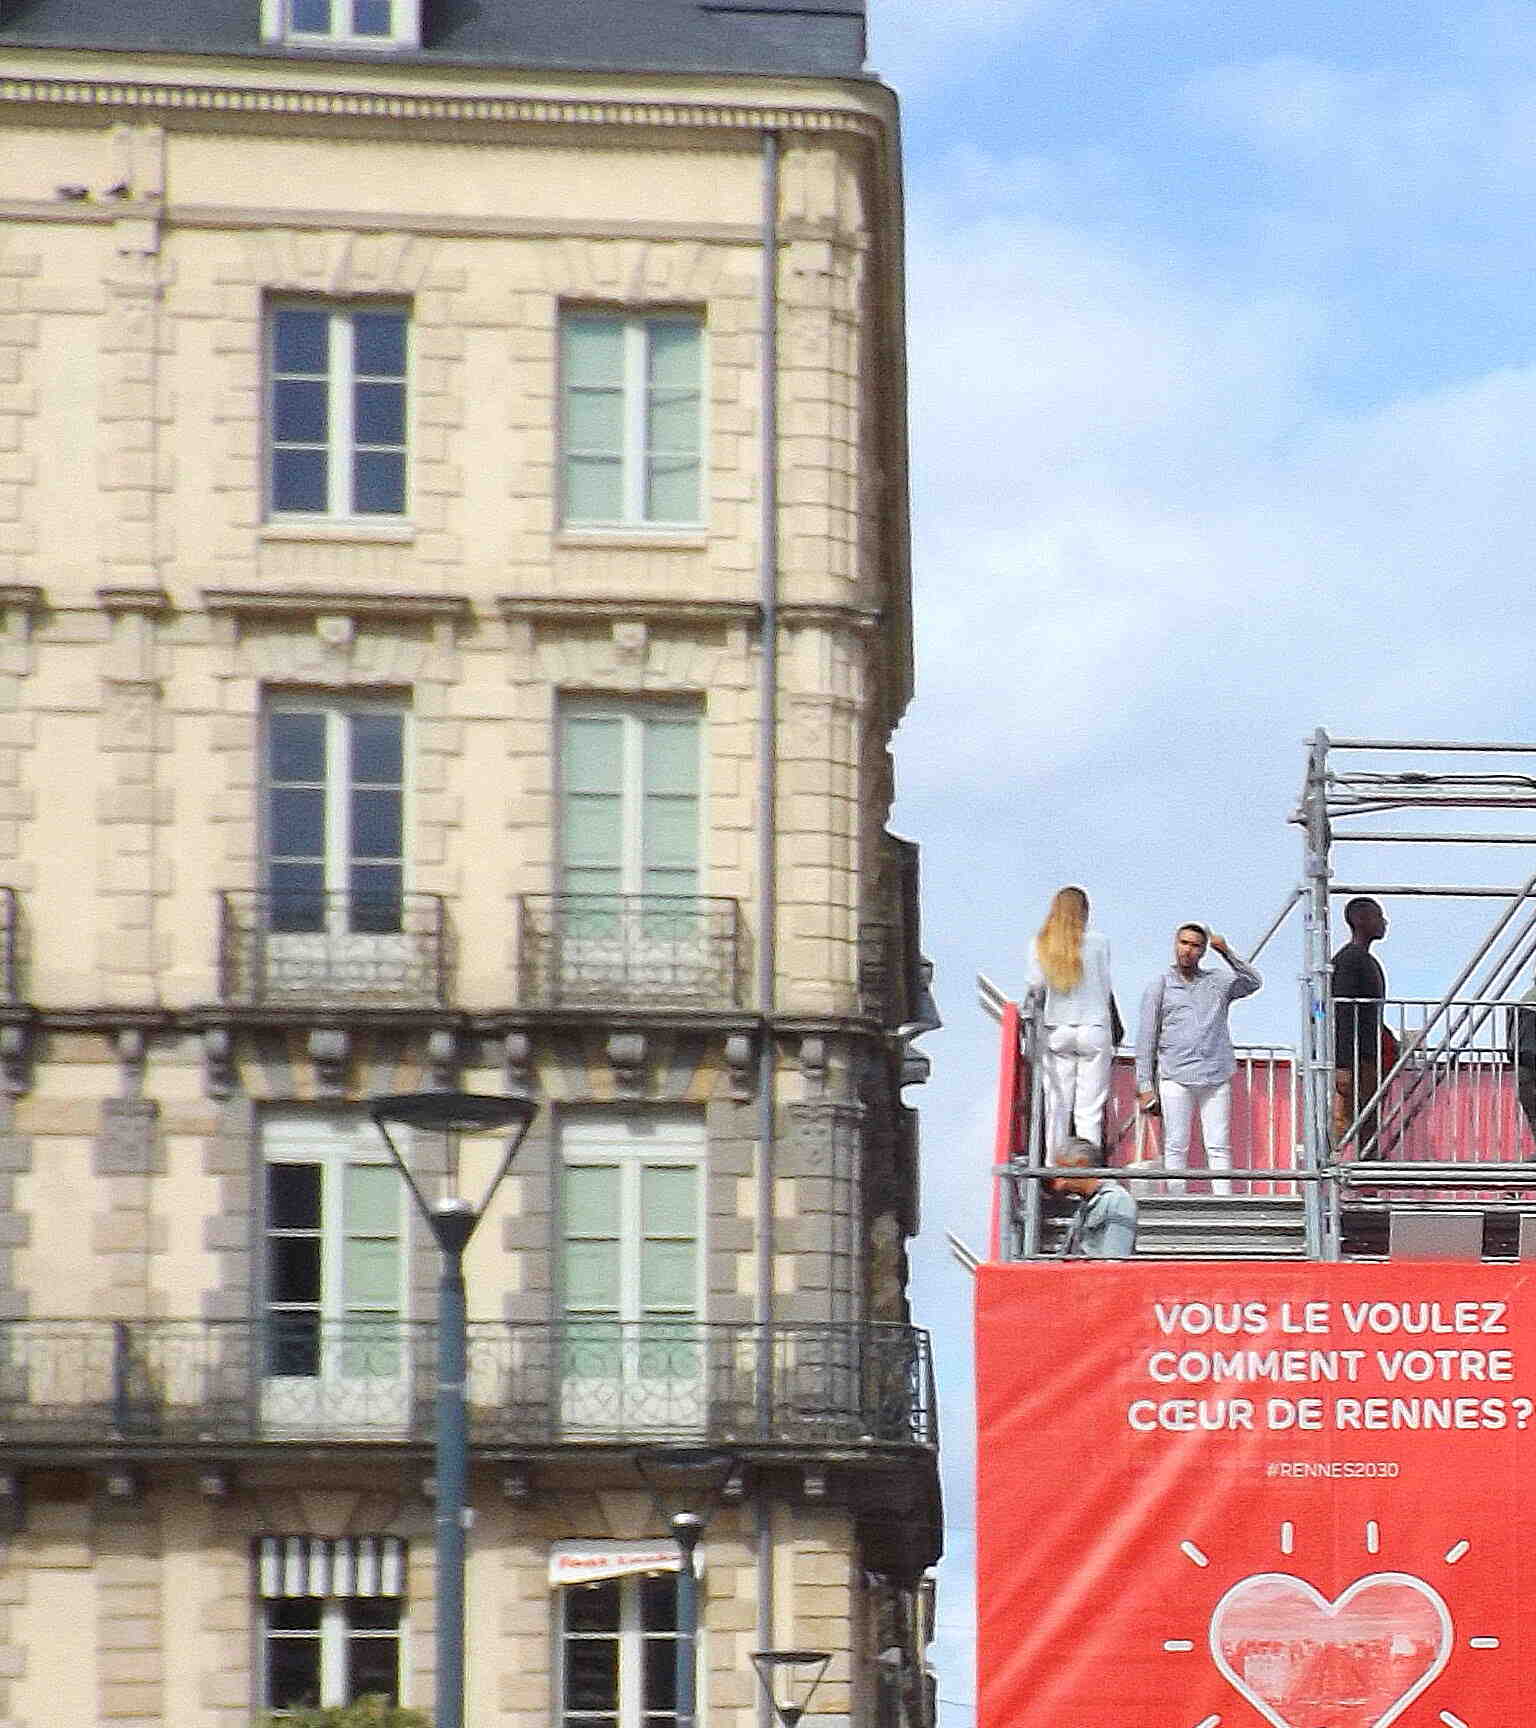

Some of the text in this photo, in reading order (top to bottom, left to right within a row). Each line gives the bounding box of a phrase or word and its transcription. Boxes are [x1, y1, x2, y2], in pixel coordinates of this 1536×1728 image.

[1155, 1302, 1509, 1335] VOUS LE VOULEZ
[1147, 1349, 1515, 1383] COMMENT VOTRE
[1127, 1398, 1256, 1432] CŒUR
[1267, 1398, 1322, 1431] DE
[1266, 1461, 1400, 1479] #RENNES2030
